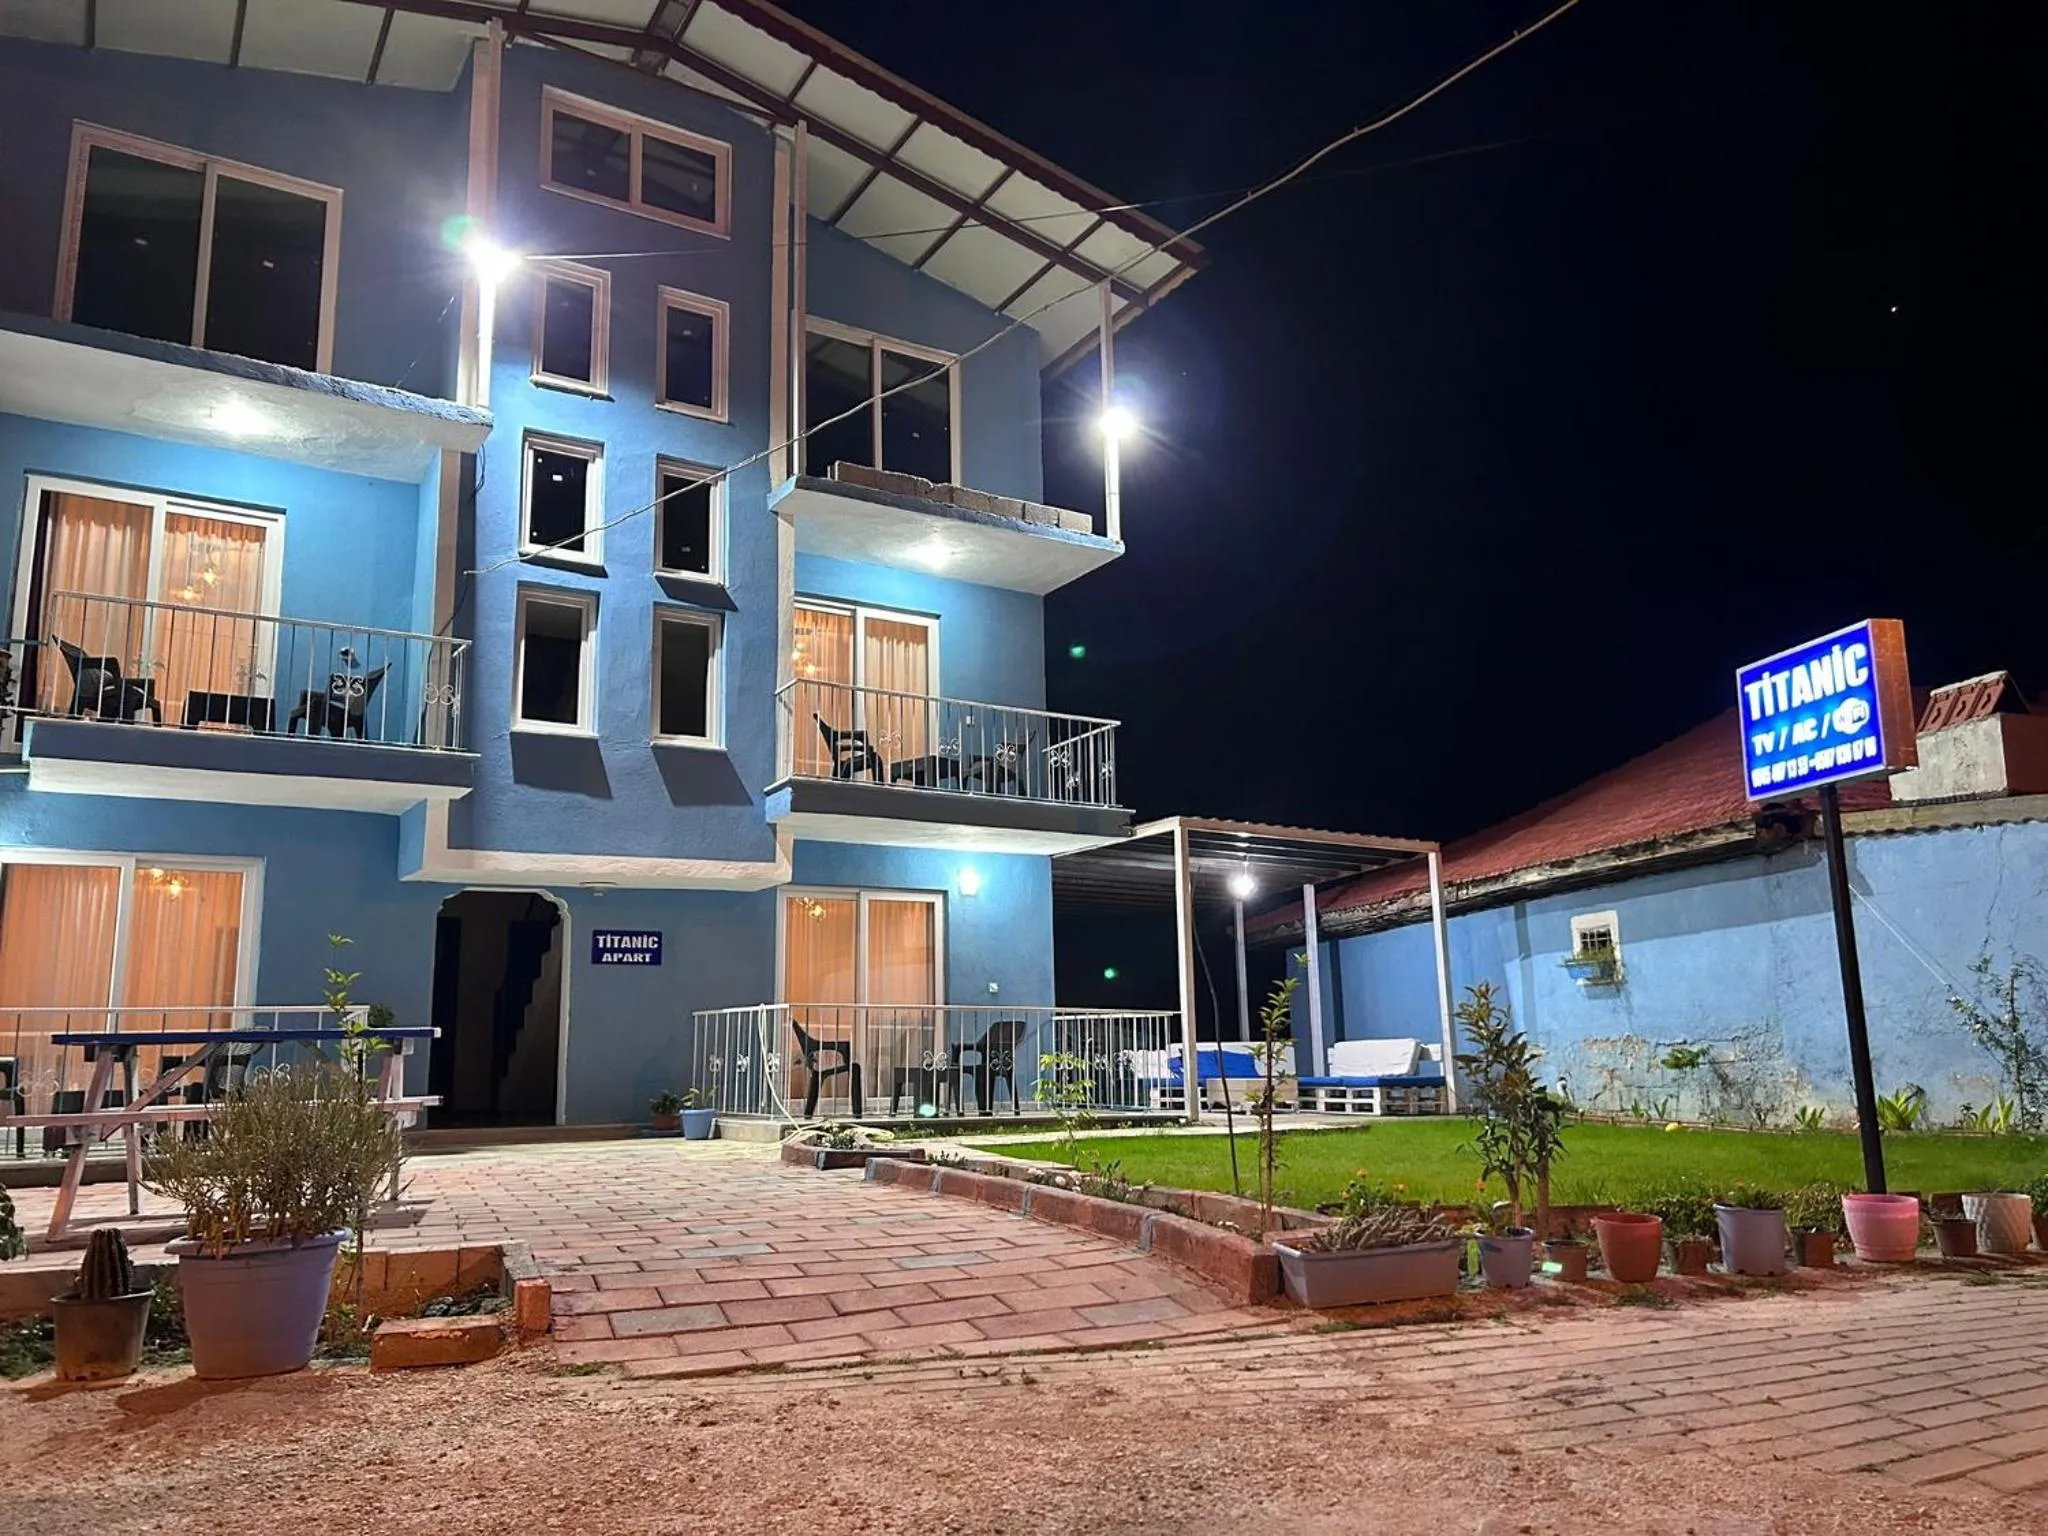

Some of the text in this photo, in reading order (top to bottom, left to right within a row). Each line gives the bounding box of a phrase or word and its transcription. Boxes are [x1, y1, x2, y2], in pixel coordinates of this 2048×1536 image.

[1752, 732, 1775, 756] TV
[1779, 726, 1787, 751] /
[1792, 719, 1818, 745] AC
[1821, 713, 1830, 740] /
[602, 953, 653, 962] APART
